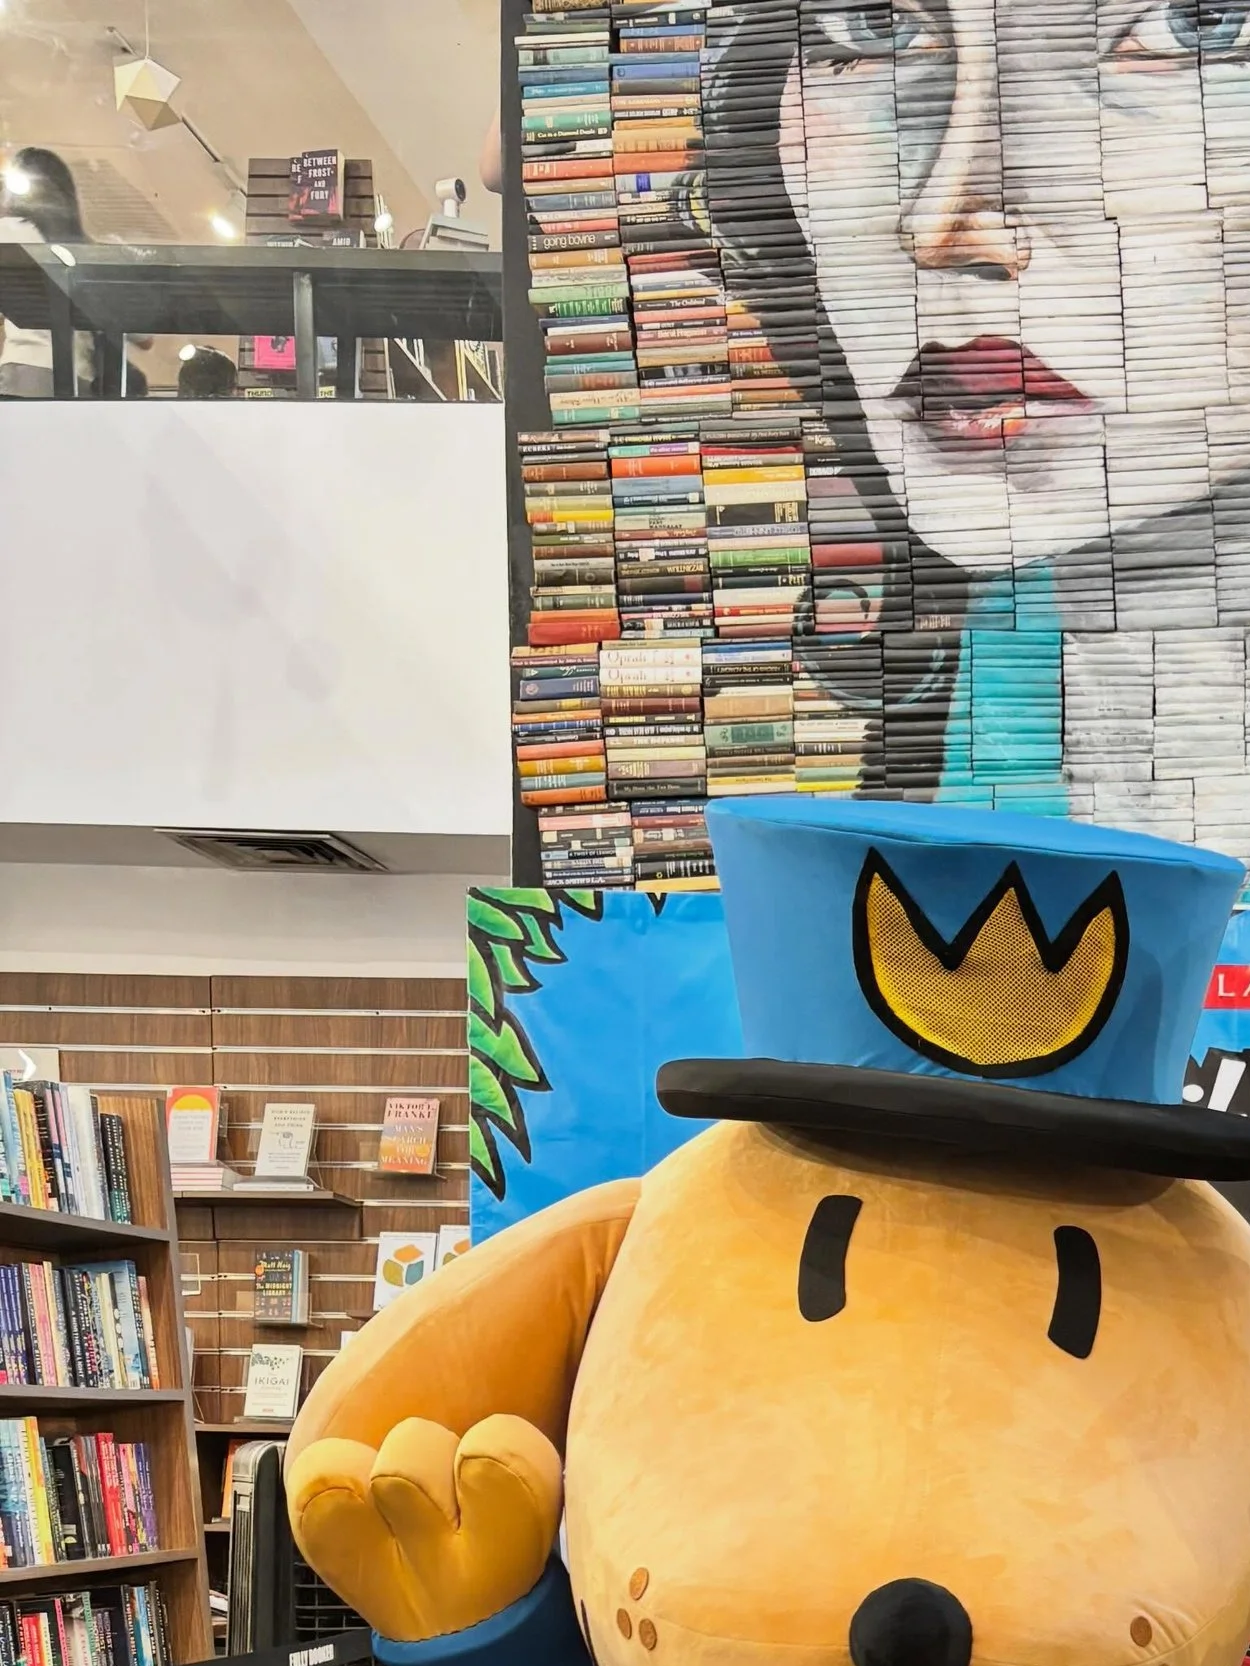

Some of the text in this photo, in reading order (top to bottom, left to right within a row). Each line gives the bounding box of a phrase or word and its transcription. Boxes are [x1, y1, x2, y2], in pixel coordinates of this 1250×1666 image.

[303, 155, 337, 167] BETWEEN
[308, 167, 330, 178] FROST
[314, 180, 326, 188] AND
[310, 190, 329, 201] FURY
[543, 233, 596, 250] going bovine
[607, 650, 647, 666] Oprah
[608, 668, 647, 683] Oprah
[381, 1155, 427, 1165] MEANING
[265, 1282, 292, 1290] MIDNIGHT
[71, 1316, 81, 1356] NORTHERN
[76, 1356, 85, 1379] LIGHT
[254, 1376, 290, 1386] IKIGAI
[308, 1643, 335, 1666] BOOKED
